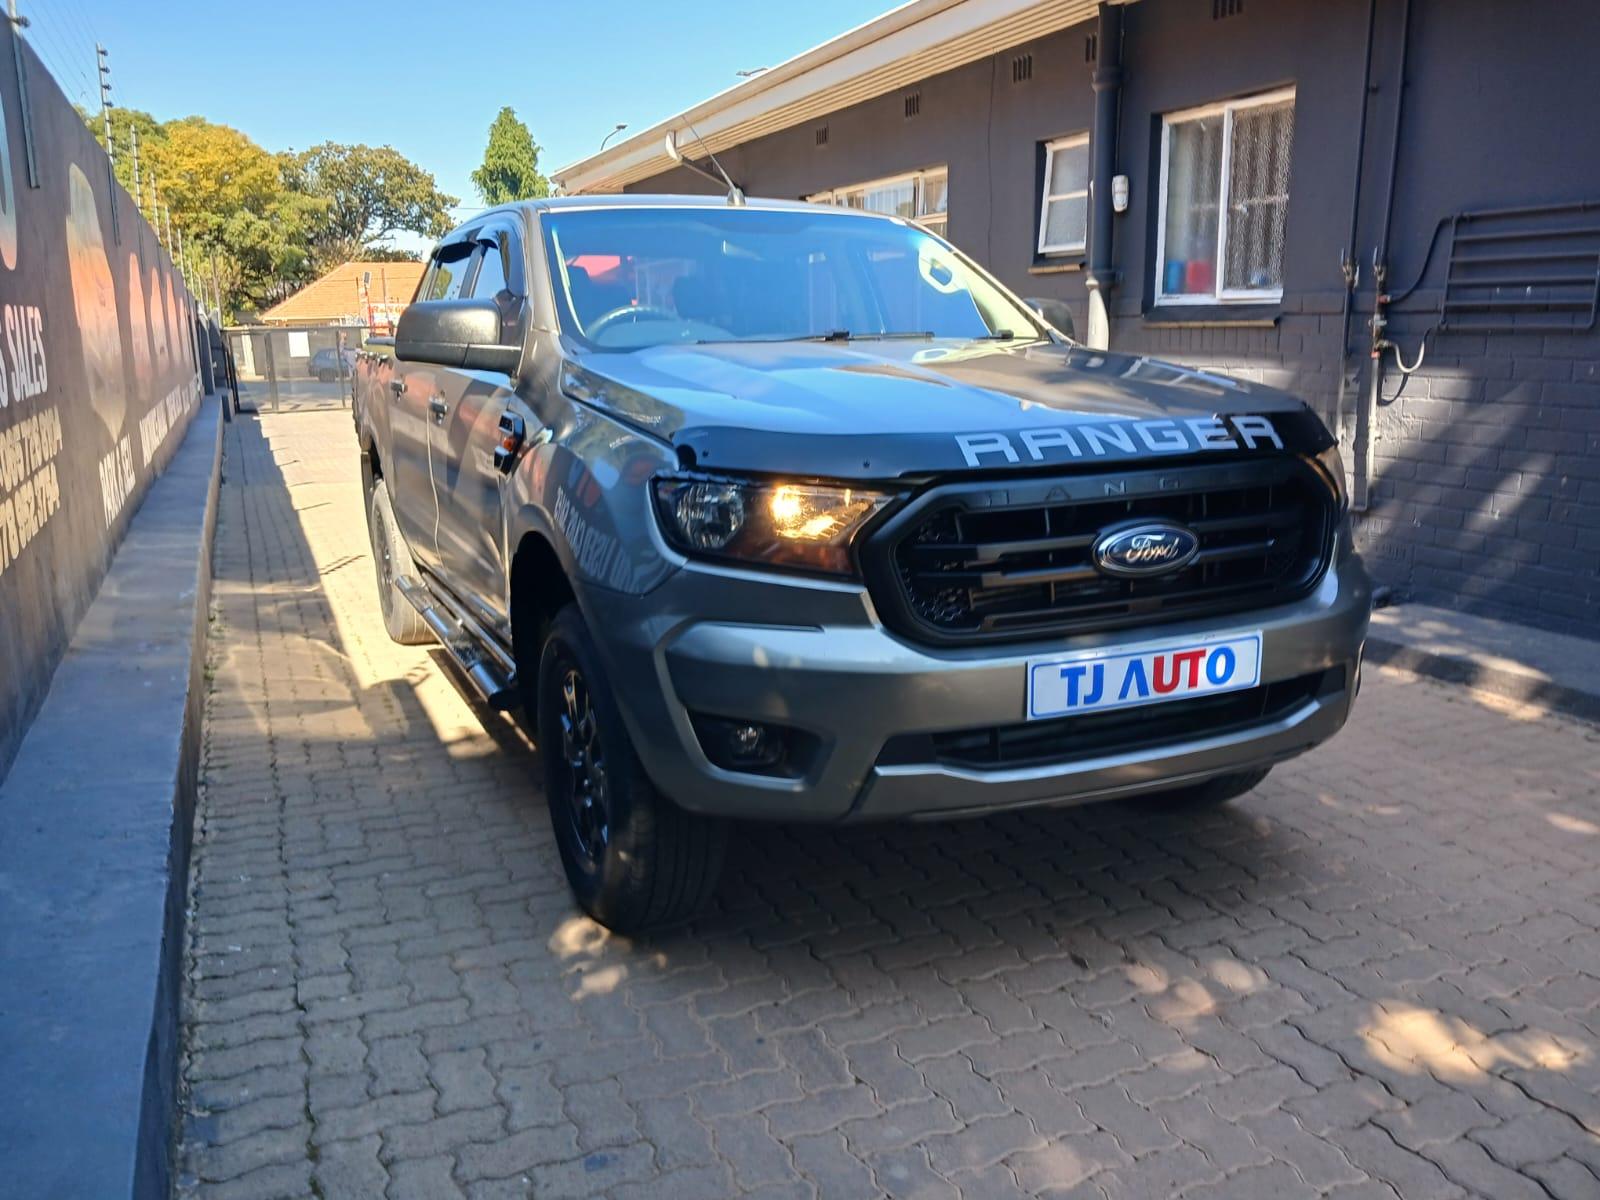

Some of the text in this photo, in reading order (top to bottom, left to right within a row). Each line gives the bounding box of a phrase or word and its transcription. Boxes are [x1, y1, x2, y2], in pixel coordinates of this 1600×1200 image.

[5, 303, 48, 402] SALES
[954, 414, 1285, 467] RANGER
[1125, 533, 1180, 562] Ford
[1060, 645, 1236, 708] TJ AUTO
